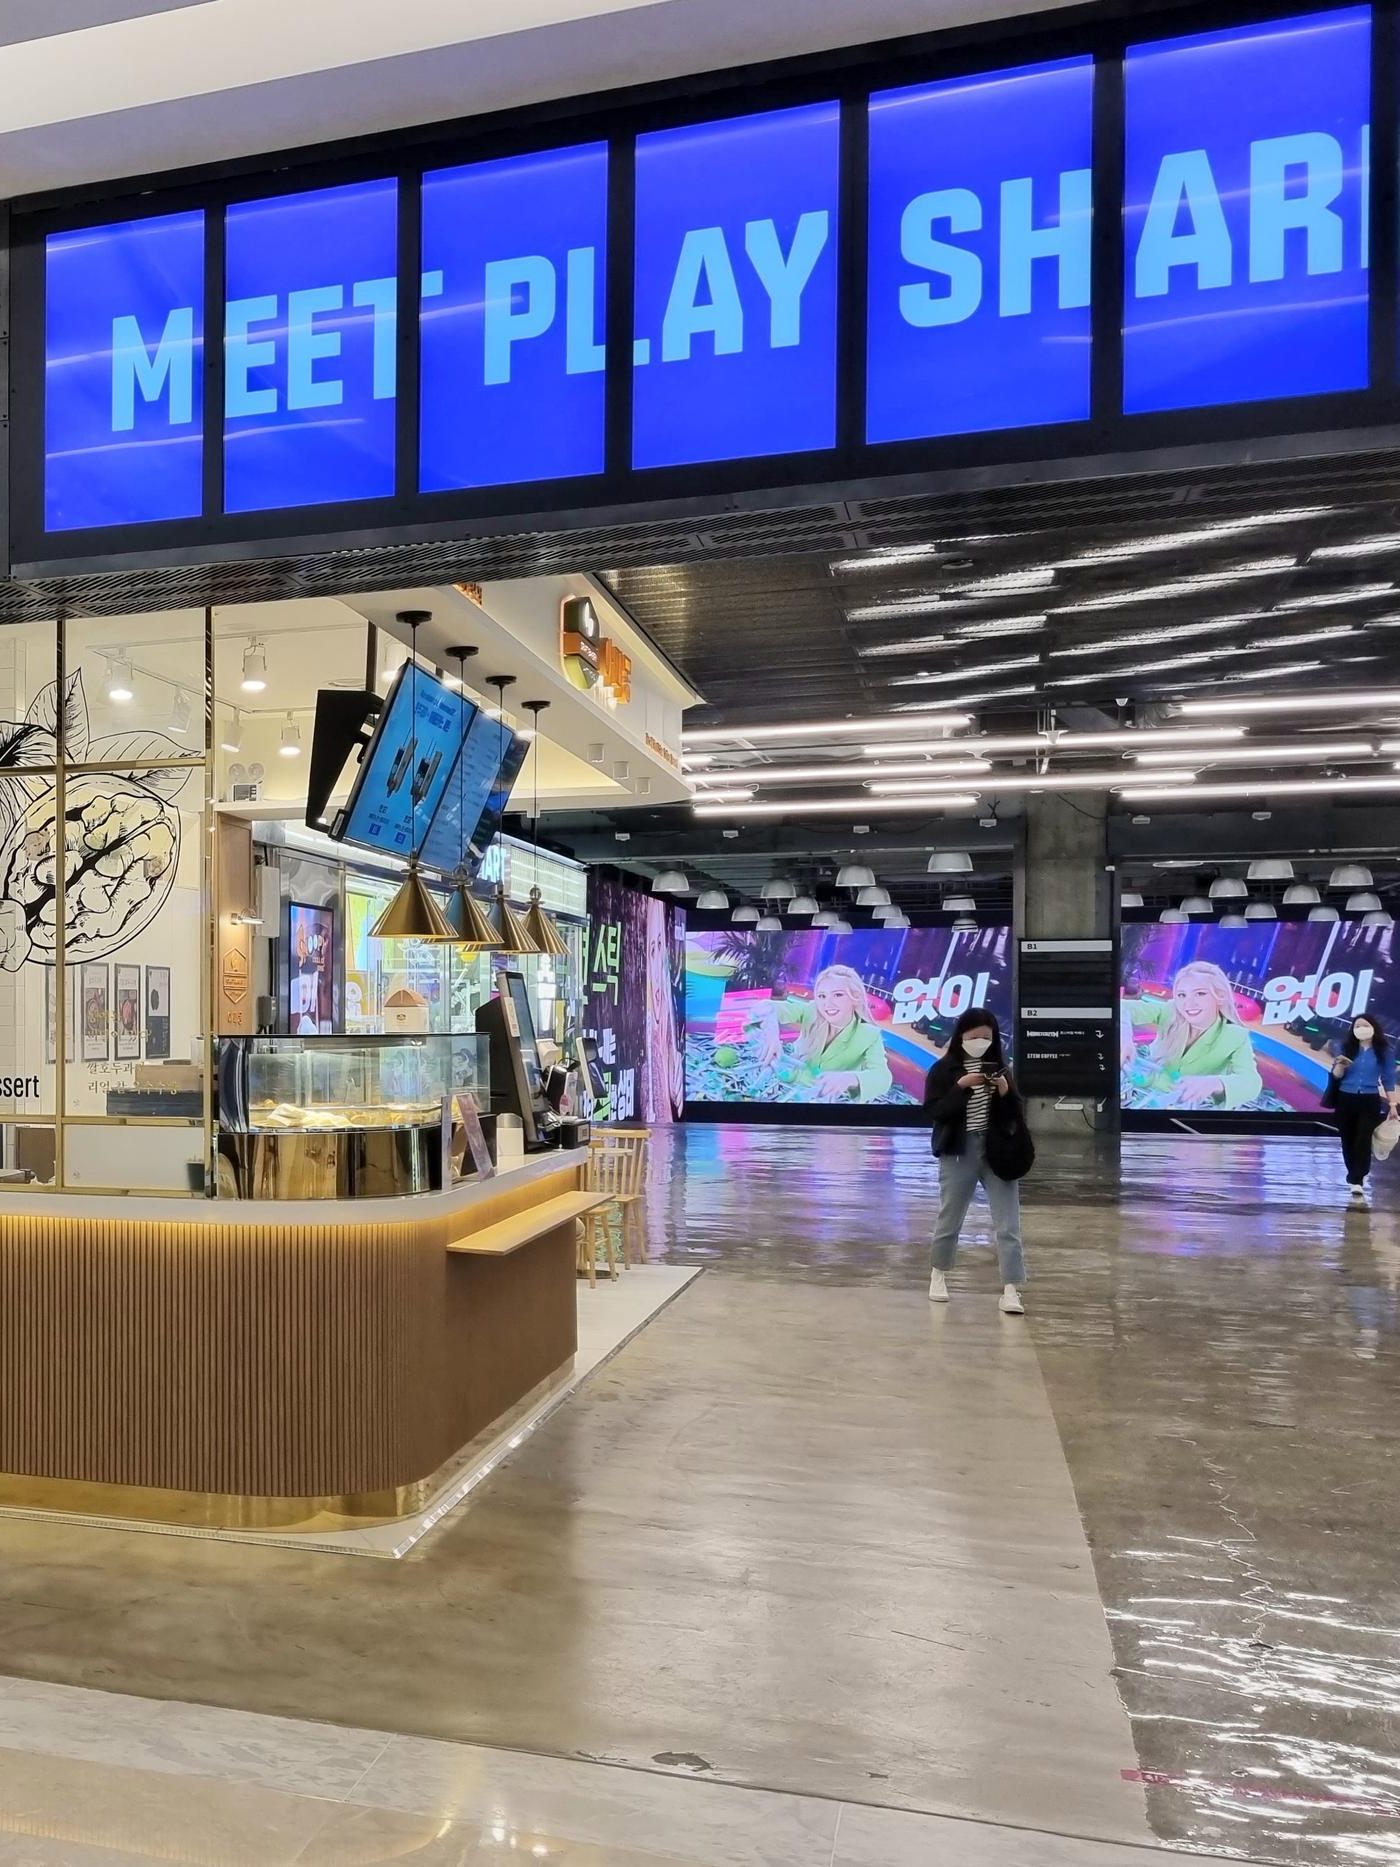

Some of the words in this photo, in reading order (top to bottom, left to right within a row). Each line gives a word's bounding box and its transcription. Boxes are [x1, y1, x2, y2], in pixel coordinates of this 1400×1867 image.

[110, 270, 444, 432] MEET
[484, 210, 830, 386] PLAY
[899, 123, 1370, 329] SHAR
[892, 972, 991, 1025] 없이
[1262, 969, 1374, 1026] 없이
